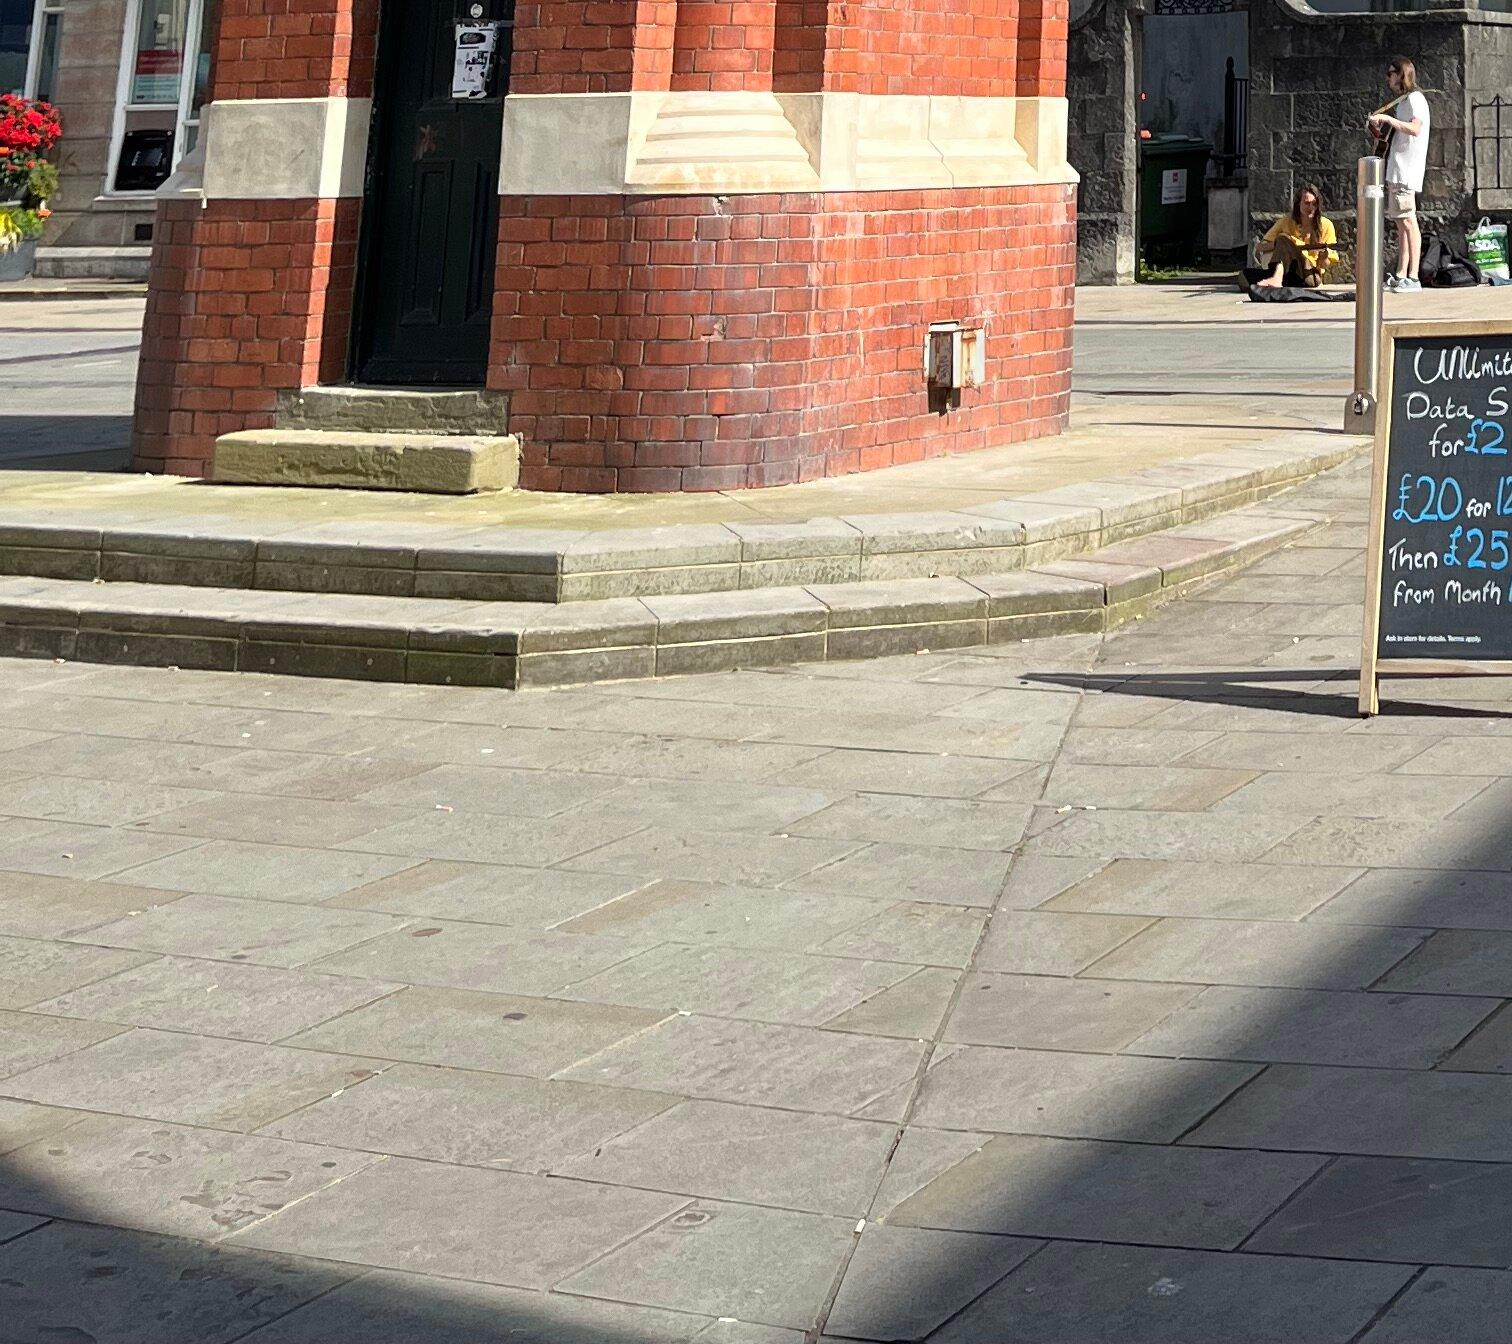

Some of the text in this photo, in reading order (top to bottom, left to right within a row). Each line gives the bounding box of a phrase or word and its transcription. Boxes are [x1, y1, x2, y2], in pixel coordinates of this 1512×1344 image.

[1406, 391, 1475, 420] Data
[1428, 423, 1464, 458] for
[1392, 473, 1462, 523] £20
[1466, 498, 1492, 518] for
[1388, 538, 1438, 571] Then
[1443, 525, 1509, 570] £25
[1393, 580, 1434, 607] from
[1445, 579, 1502, 605] Month
